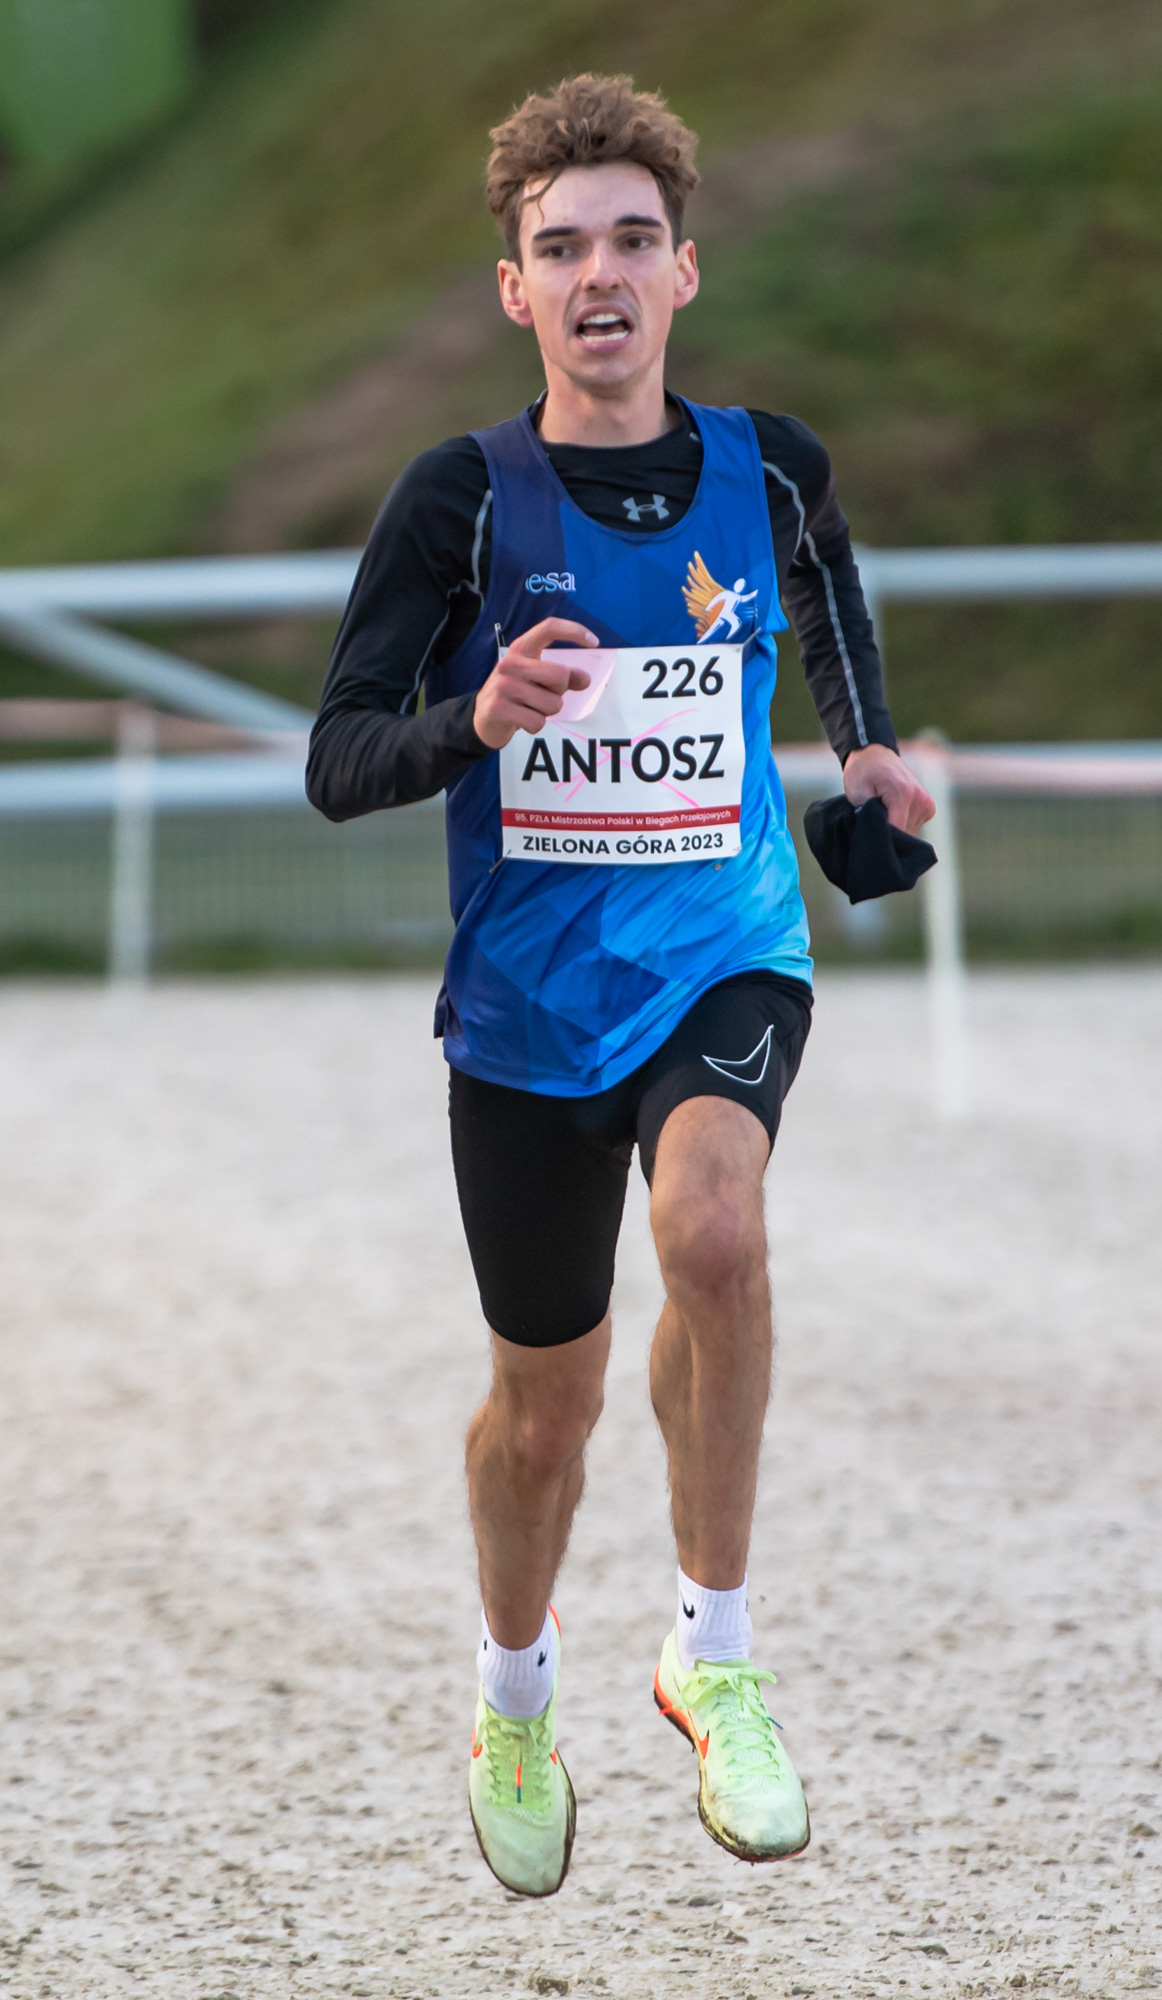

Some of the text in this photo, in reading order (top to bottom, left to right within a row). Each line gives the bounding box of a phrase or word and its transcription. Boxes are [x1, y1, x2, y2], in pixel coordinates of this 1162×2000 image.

[642, 655, 724, 699] 226
[521, 733, 725, 783] ANTOSZ
[529, 814, 550, 823] PZLA
[551, 815, 606, 825] Mistrzostwa
[607, 816, 634, 825] Polski
[635, 817, 643, 825] w
[645, 815, 680, 827] Biegach
[523, 832, 724, 854] ZIELONA GÓRA 2023
